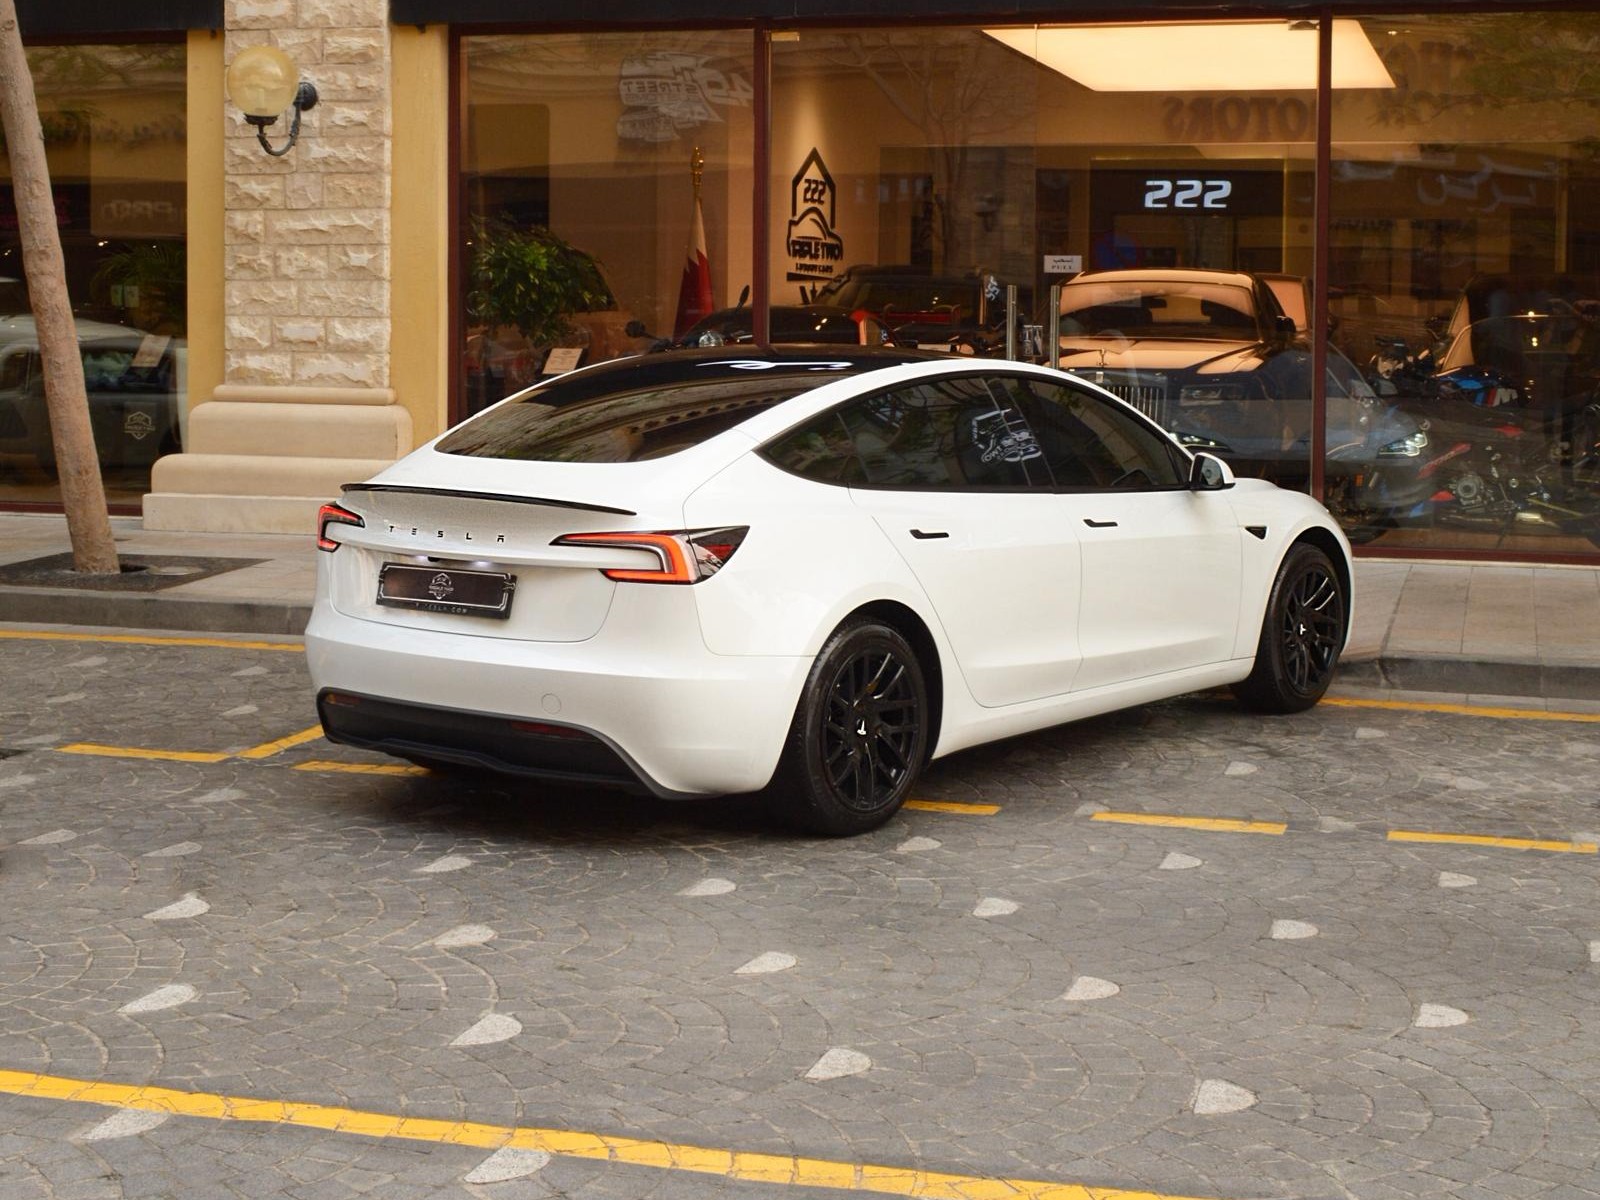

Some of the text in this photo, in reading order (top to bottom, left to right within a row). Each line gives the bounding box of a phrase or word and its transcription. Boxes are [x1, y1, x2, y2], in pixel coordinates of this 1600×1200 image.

[803, 179, 826, 204] 222
[1144, 180, 1232, 208] 222
[389, 525, 505, 543] TESLA
